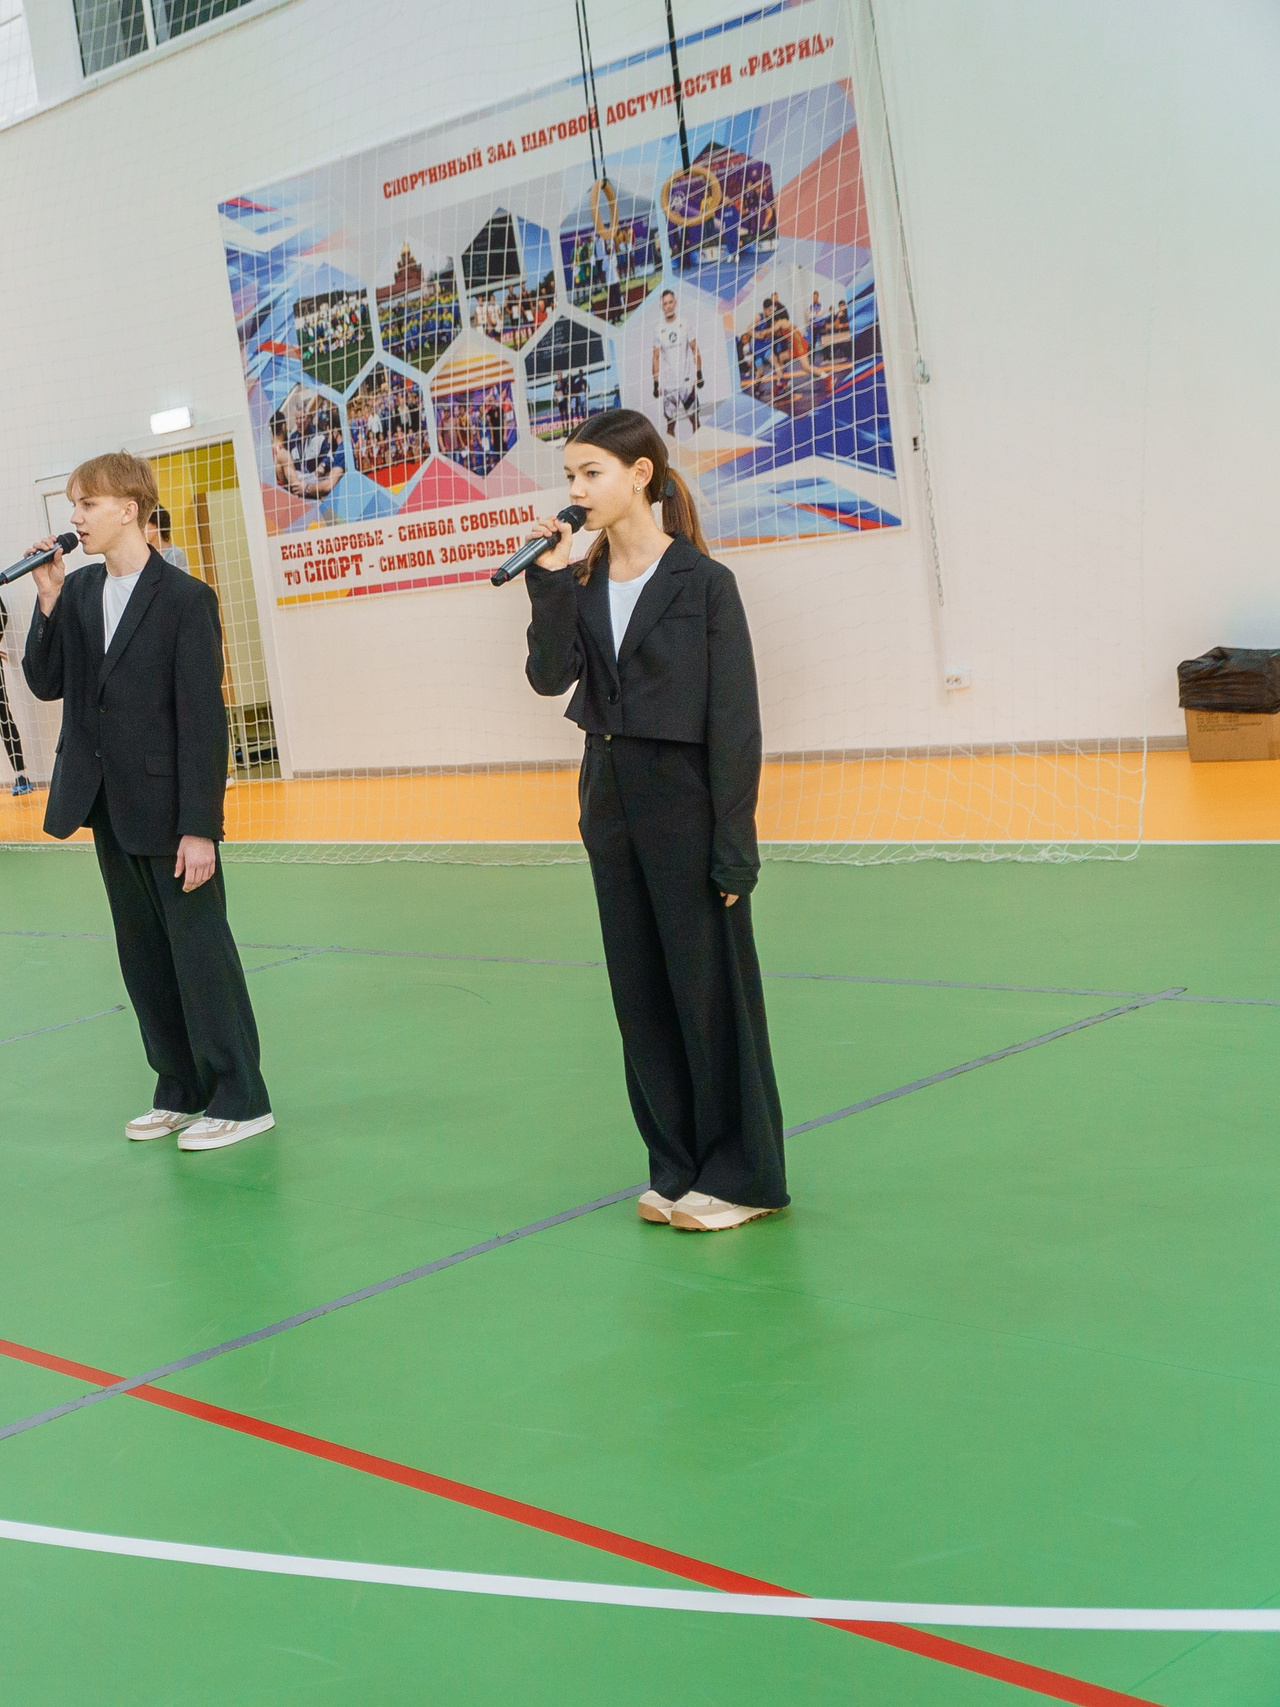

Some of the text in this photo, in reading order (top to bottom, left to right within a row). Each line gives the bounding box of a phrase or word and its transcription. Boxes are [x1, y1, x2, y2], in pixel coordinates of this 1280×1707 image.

[382, 147, 483, 199] СПОРТИВНЫЙ
[486, 139, 517, 164] ЗАЛ
[521, 106, 600, 153] ШАГОВОЙ
[739, 32, 834, 77] «РАЗРЯД»
[280, 541, 313, 561] ЕСЛИ
[316, 529, 384, 555] ЗДОРОВЬЕ
[398, 521, 457, 542] СИМВОЛ
[303, 553, 363, 583] СПОРТ
[379, 551, 435, 573] СИМВОЛ
